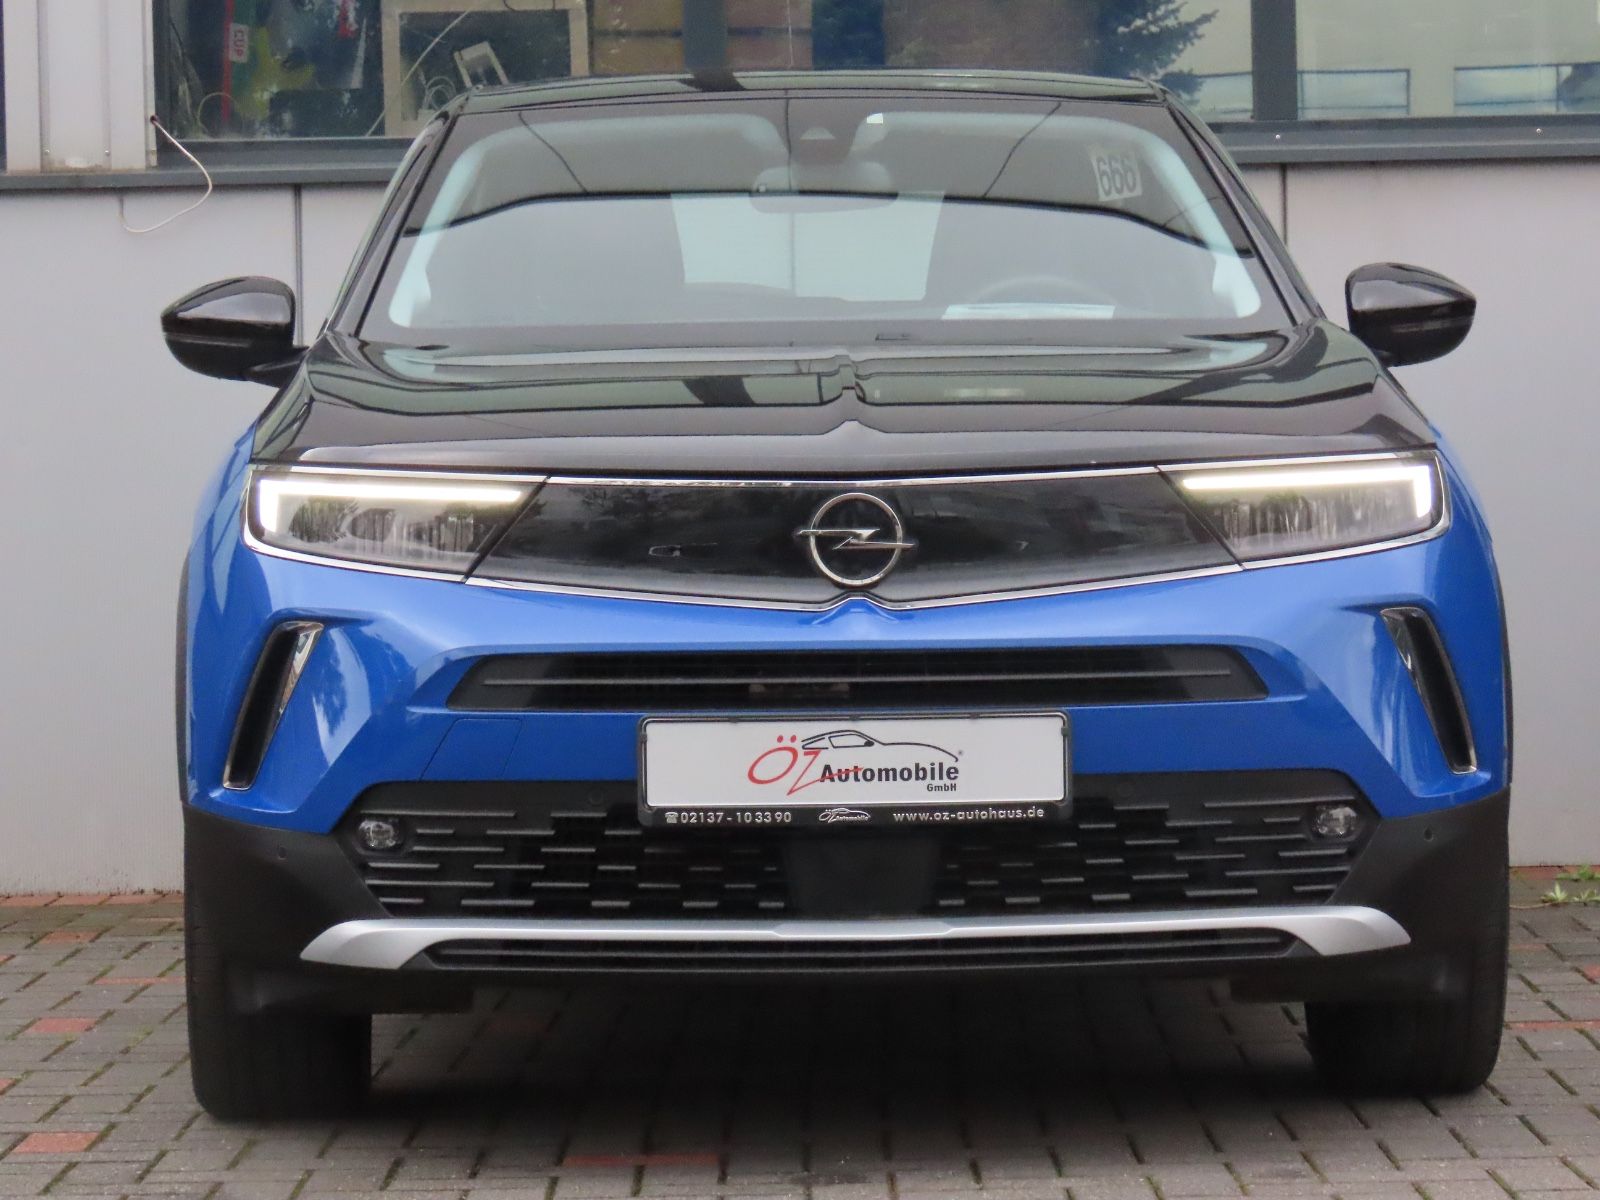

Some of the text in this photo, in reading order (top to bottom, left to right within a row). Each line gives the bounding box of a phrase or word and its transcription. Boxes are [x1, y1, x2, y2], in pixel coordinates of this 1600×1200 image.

[233, 28, 244, 58] CUP
[1096, 154, 1137, 197] 666
[748, 734, 824, 796] ÖZ
[819, 761, 960, 783] Automobile
[926, 783, 957, 793] GmbH
[892, 806, 1046, 823] www.oz-autohaus.de
